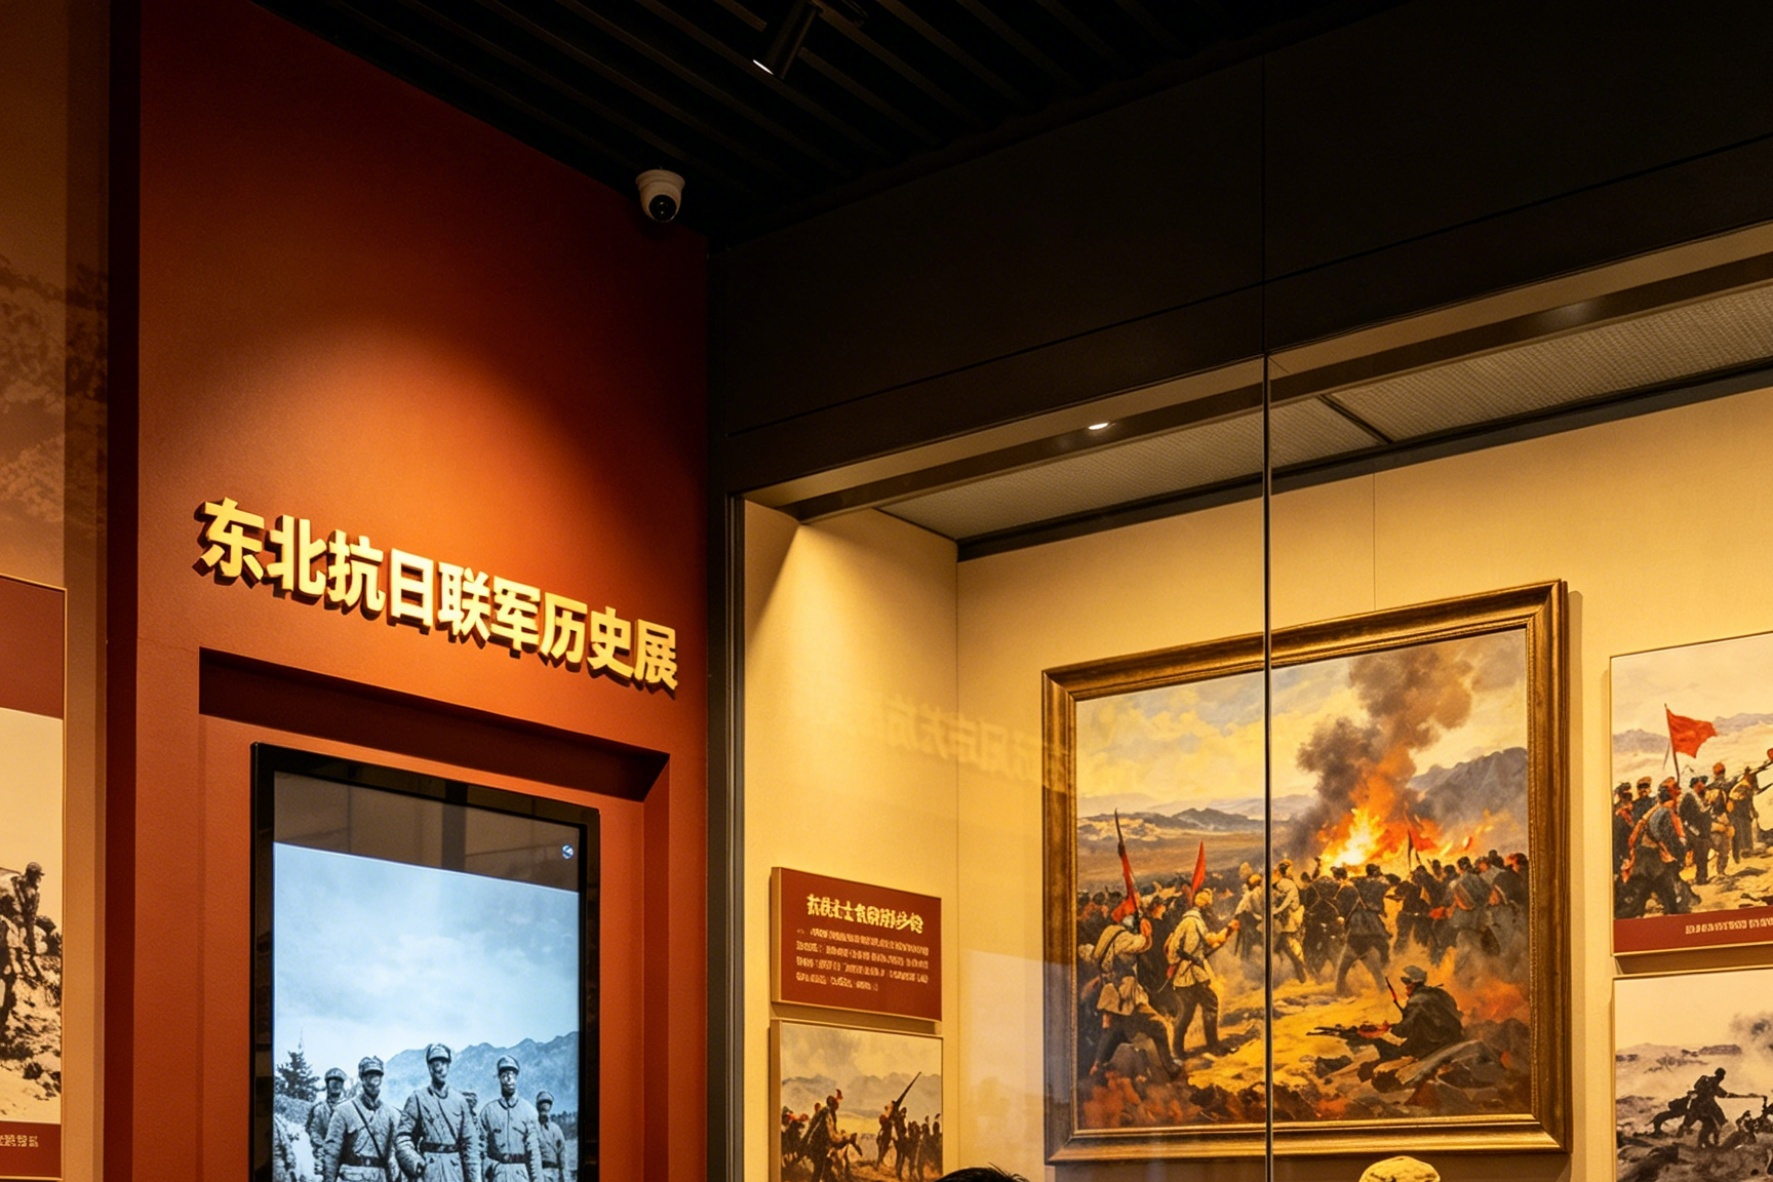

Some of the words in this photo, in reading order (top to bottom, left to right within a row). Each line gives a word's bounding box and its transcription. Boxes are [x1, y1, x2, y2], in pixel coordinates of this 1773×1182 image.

[198, 496, 679, 691] 东北抗日联军历史展
